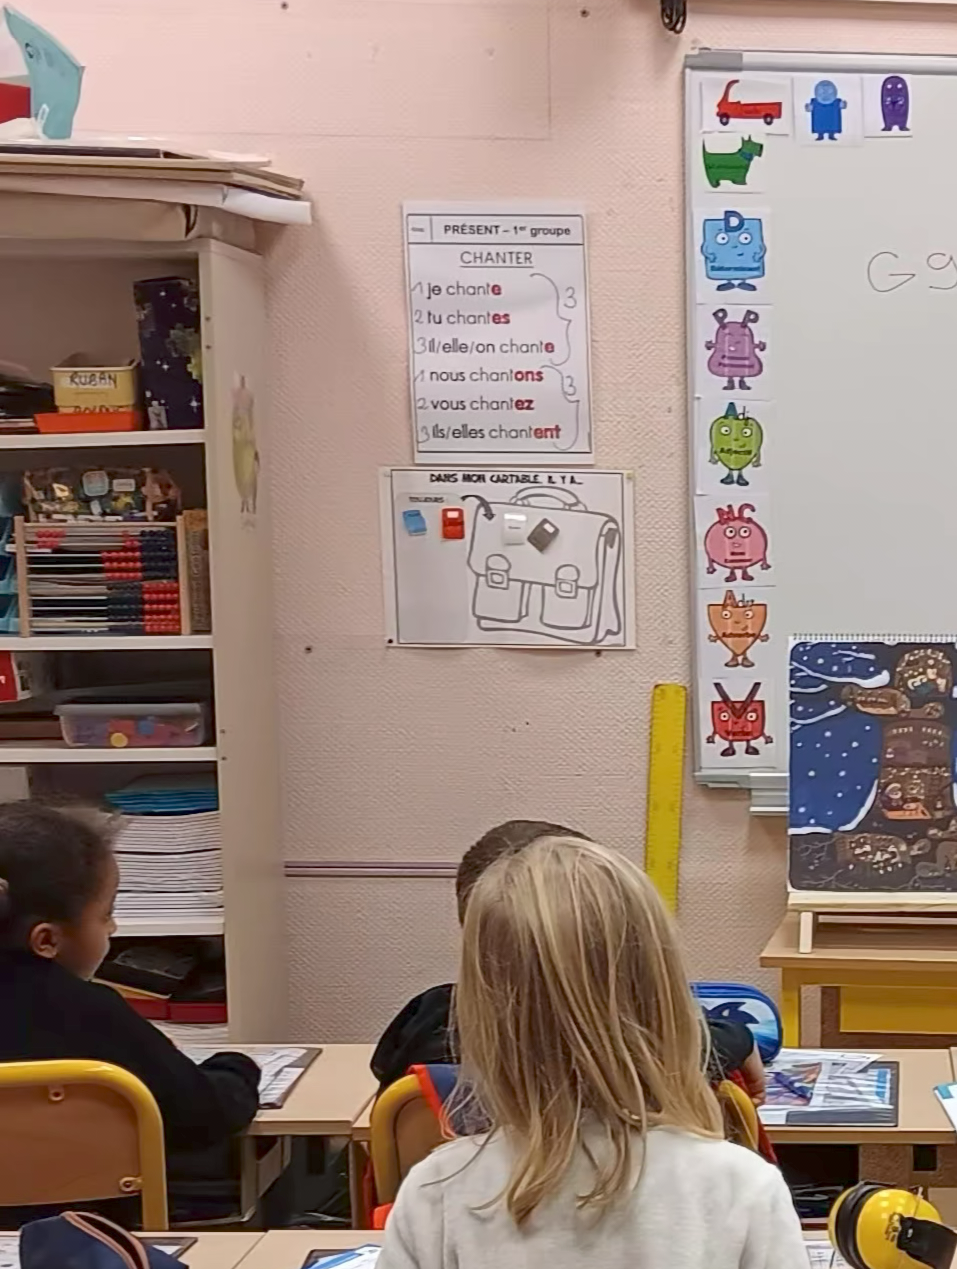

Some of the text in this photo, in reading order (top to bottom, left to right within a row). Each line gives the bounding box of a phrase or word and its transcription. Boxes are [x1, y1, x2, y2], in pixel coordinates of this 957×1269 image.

[444, 223, 500, 235] PRÉSENT
[530, 226, 571, 237] groupe
[460, 251, 534, 265] CHANTER
[426, 282, 442, 300] je
[446, 282, 502, 295] chante
[427, 312, 443, 325] tu
[446, 311, 511, 325] chantes
[428, 339, 496, 354] il/elle/on
[500, 339, 555, 354] chante
[430, 371, 466, 382] nous
[469, 368, 544, 382] chantons
[431, 399, 467, 411] vous
[469, 396, 535, 411] chantez
[432, 425, 485, 440] ils/elles
[489, 425, 562, 440] chantent
[429, 473, 458, 483] DANS
[462, 474, 486, 483] MON
[560, 476, 566, 484] Y
